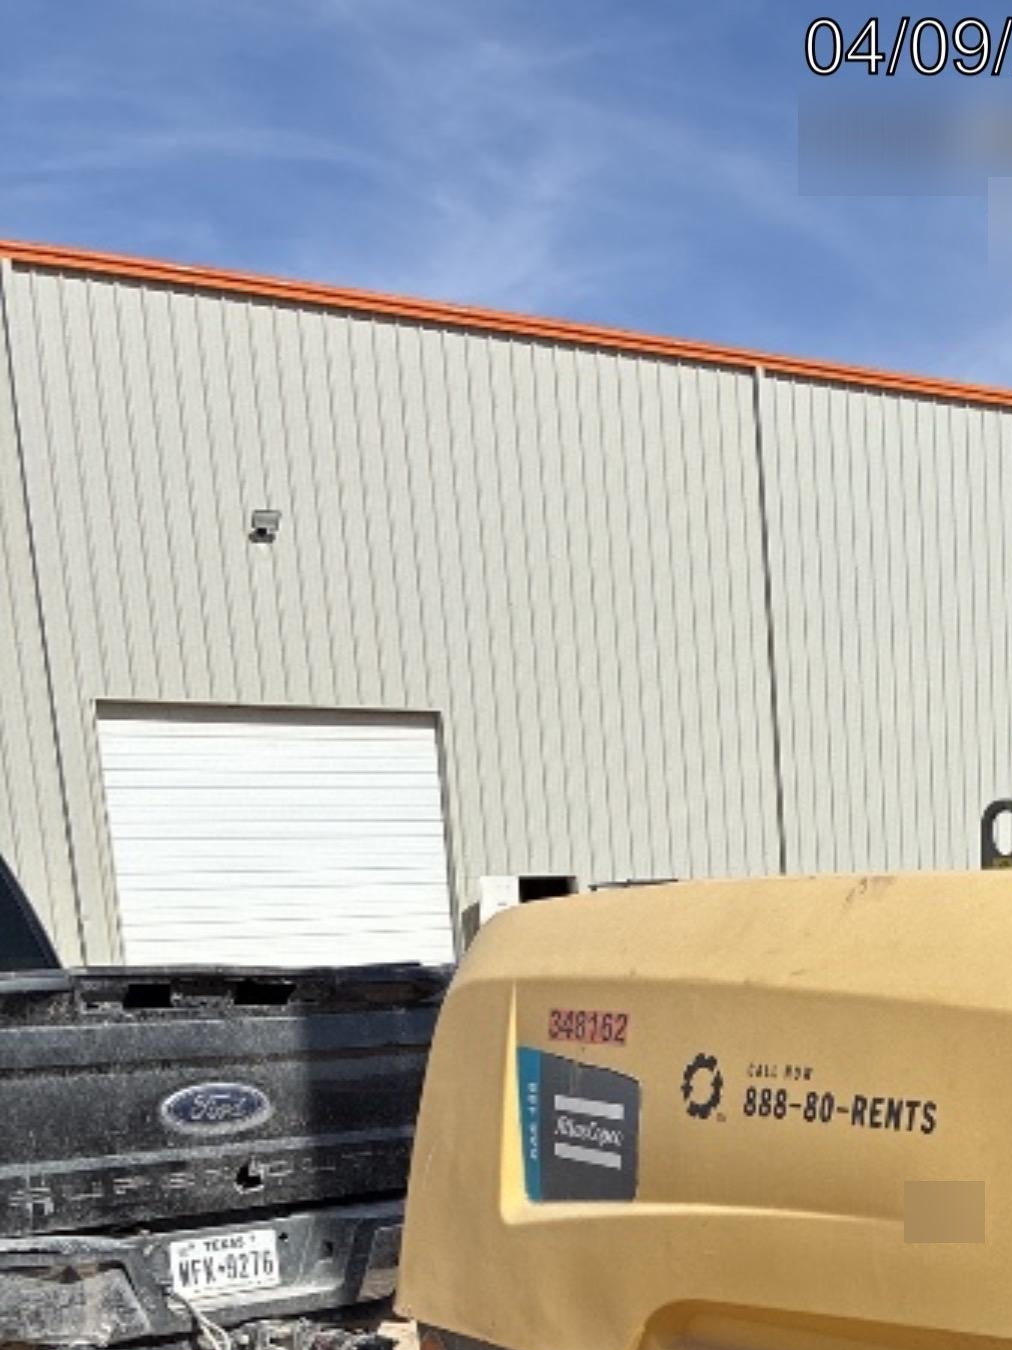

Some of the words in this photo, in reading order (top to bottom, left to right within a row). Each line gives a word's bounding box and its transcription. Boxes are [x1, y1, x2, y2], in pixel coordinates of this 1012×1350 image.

[550, 1009, 628, 1043] 348162
[191, 1096, 247, 1120] Ford
[743, 1086, 937, 1134] 888-80-RENTS
